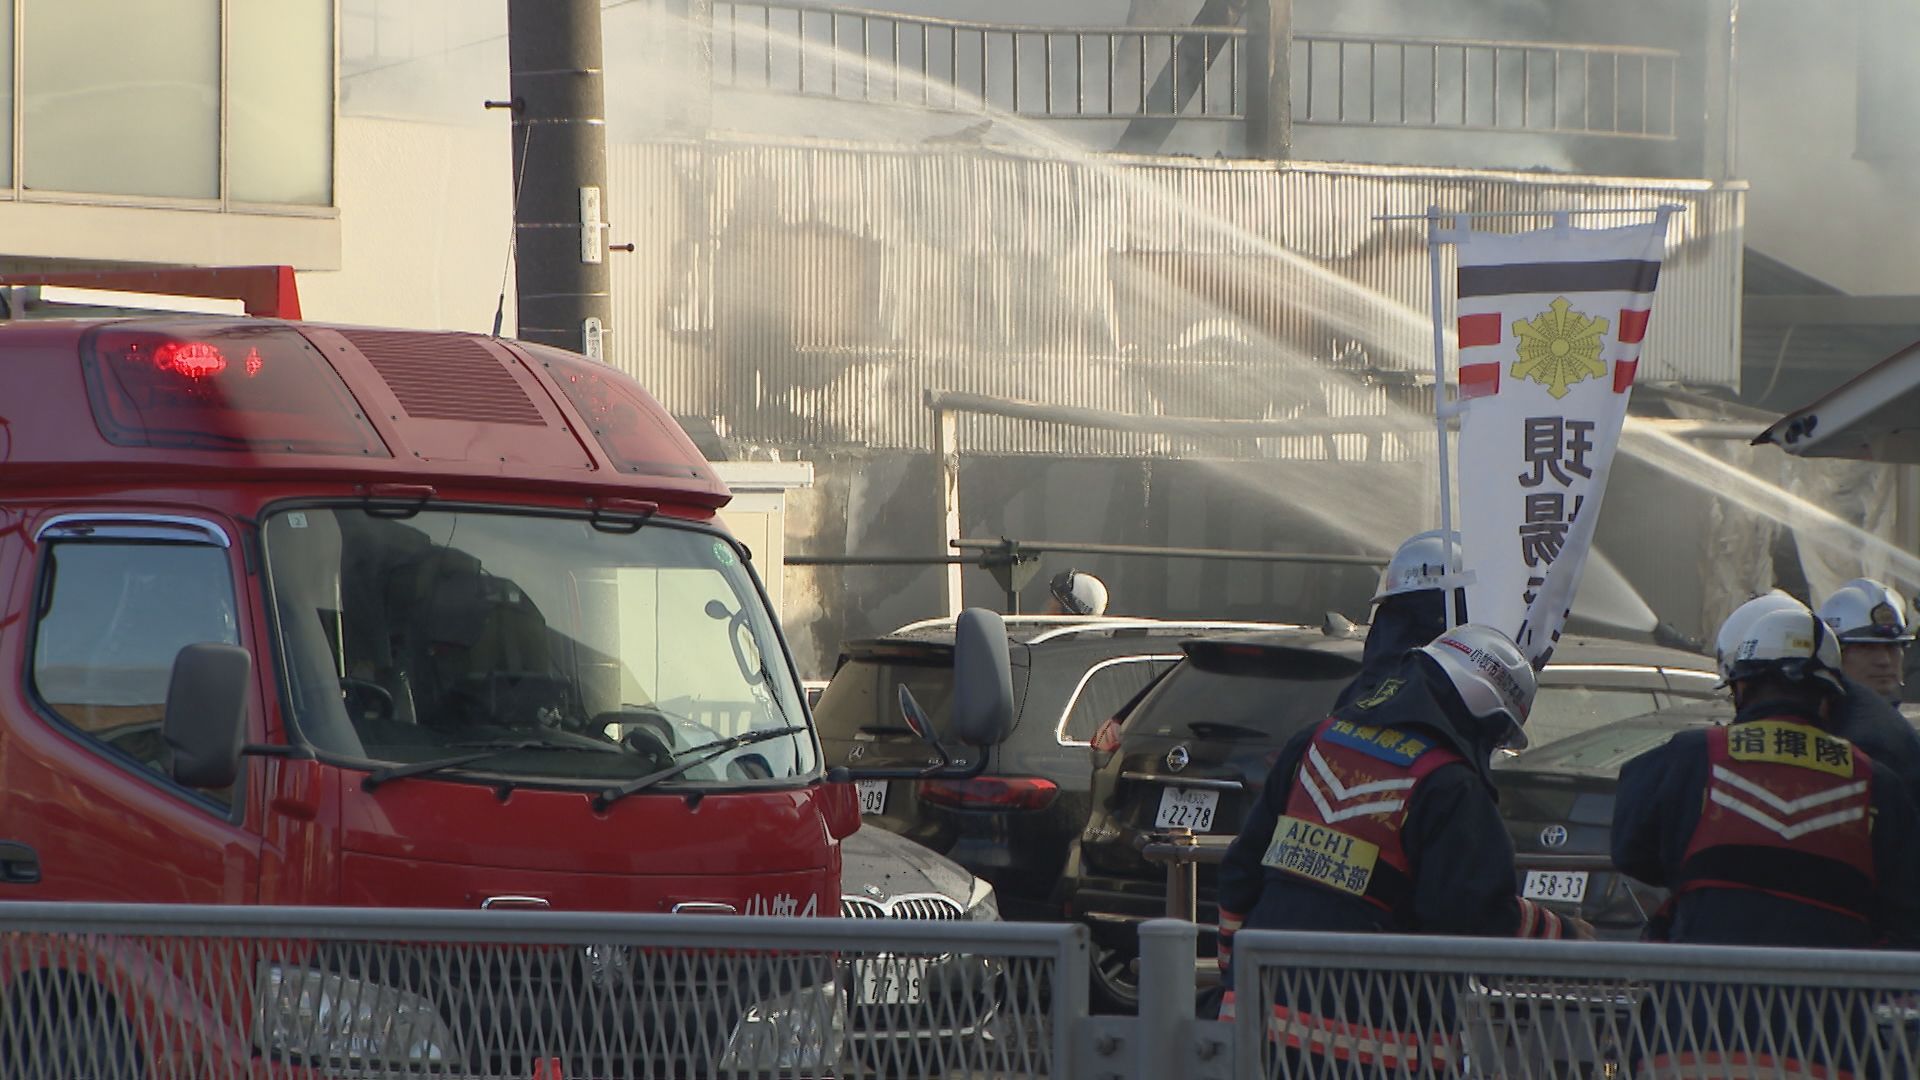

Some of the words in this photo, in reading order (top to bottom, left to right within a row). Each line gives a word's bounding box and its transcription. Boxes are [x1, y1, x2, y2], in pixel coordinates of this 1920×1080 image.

[1731, 727, 1849, 766] 指揮隊
[1168, 805, 1211, 828] 22-78
[1286, 821, 1354, 859] AICHI
[1537, 874, 1583, 898] 58-33
